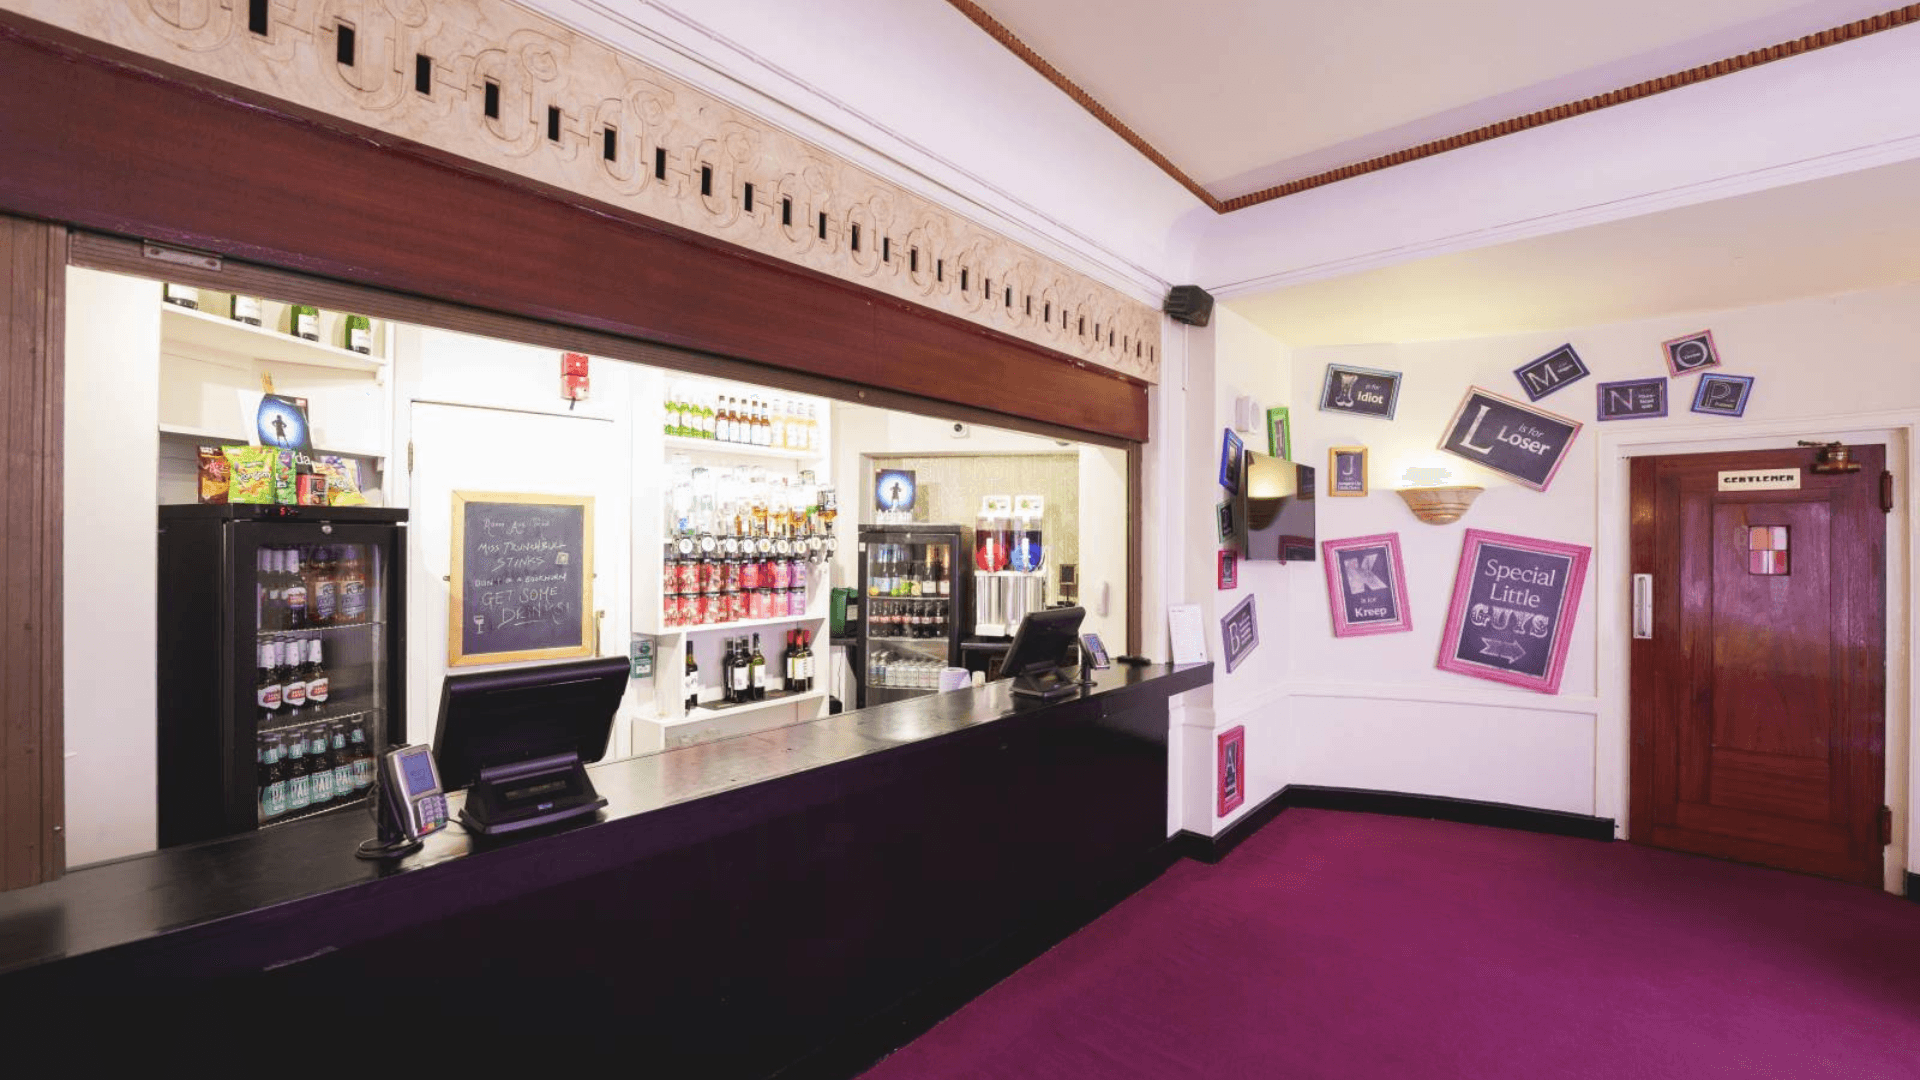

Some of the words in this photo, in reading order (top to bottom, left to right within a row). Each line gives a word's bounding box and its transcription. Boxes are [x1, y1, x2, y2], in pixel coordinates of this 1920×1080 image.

[1527, 364, 1559, 391] M
[1357, 391, 1384, 405] Idiot
[1610, 388, 1633, 412] N
[1459, 403, 1495, 456] L
[1497, 425, 1551, 456] Loser
[1519, 423, 1527, 434] is
[1527, 424, 1543, 438] for
[295, 452, 311, 465] da
[1723, 474, 1794, 483] GENTLEMEN
[1343, 553, 1388, 595] K
[1484, 558, 1556, 587] Special
[482, 589, 513, 610] GET
[519, 586, 558, 604] SOME
[1490, 583, 1540, 608] Little
[1354, 606, 1387, 618] Kreep
[1470, 603, 1550, 639] GUYS
